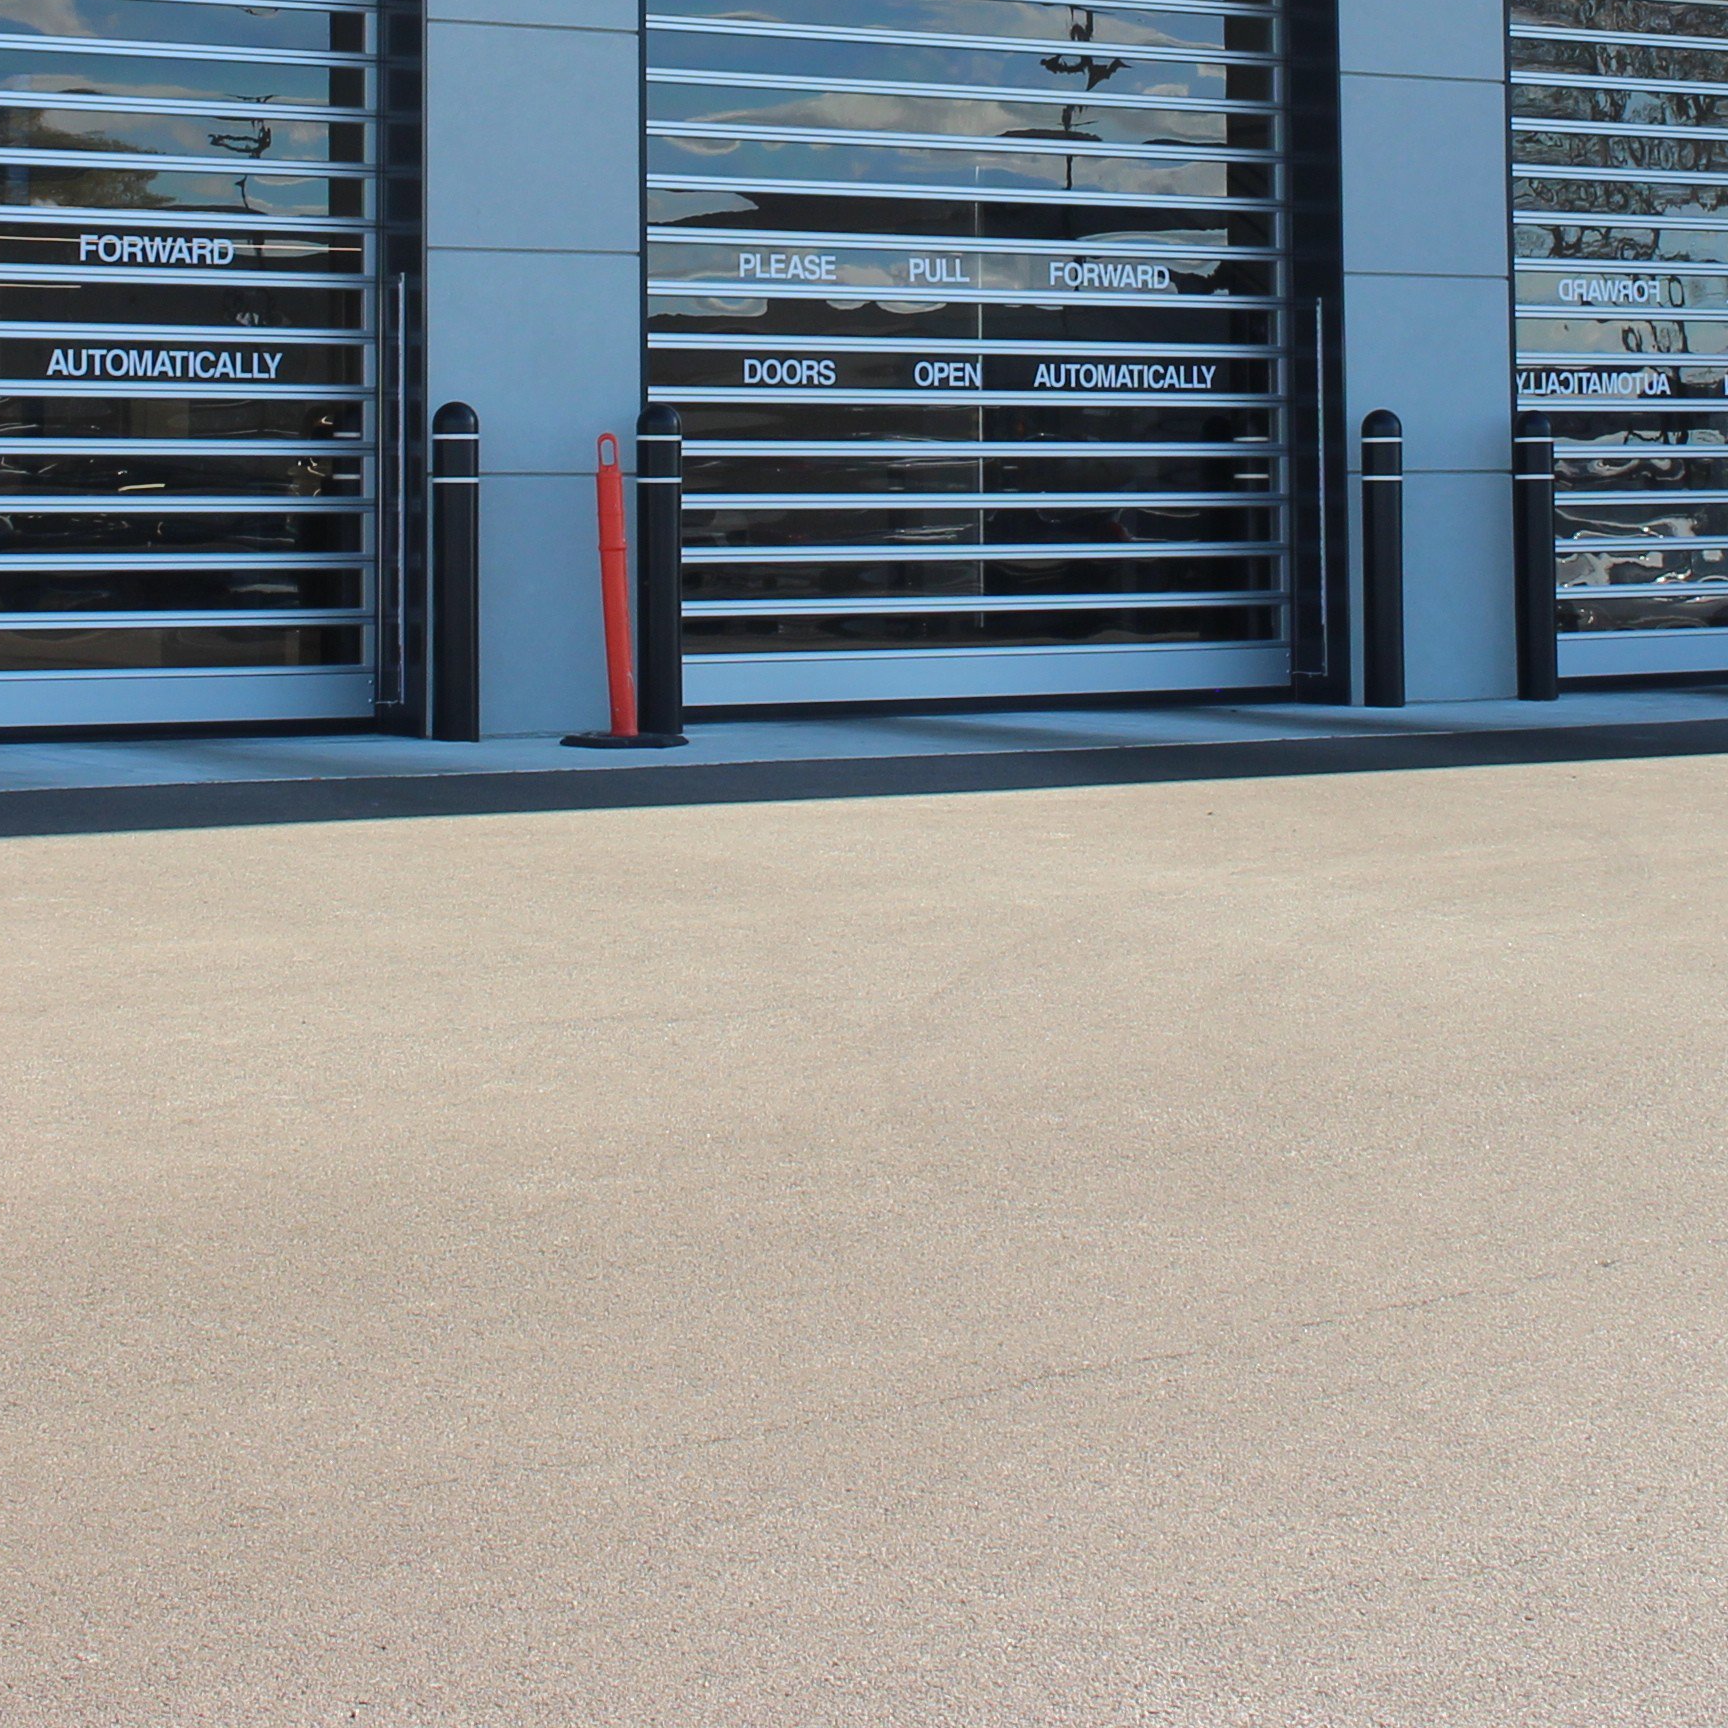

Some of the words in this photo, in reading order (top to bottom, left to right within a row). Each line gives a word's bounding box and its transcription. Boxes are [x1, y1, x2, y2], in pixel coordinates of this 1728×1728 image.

[79, 234, 235, 266] FORWARD
[738, 252, 837, 280] PLEASE
[908, 257, 970, 283] PULL
[1049, 261, 1171, 289] FORWARD
[46, 347, 283, 380] AUTOMATICALLY
[743, 358, 836, 385] DOORS
[913, 360, 983, 388] OPEN
[1033, 363, 1217, 390] AUTOMATICALLY
